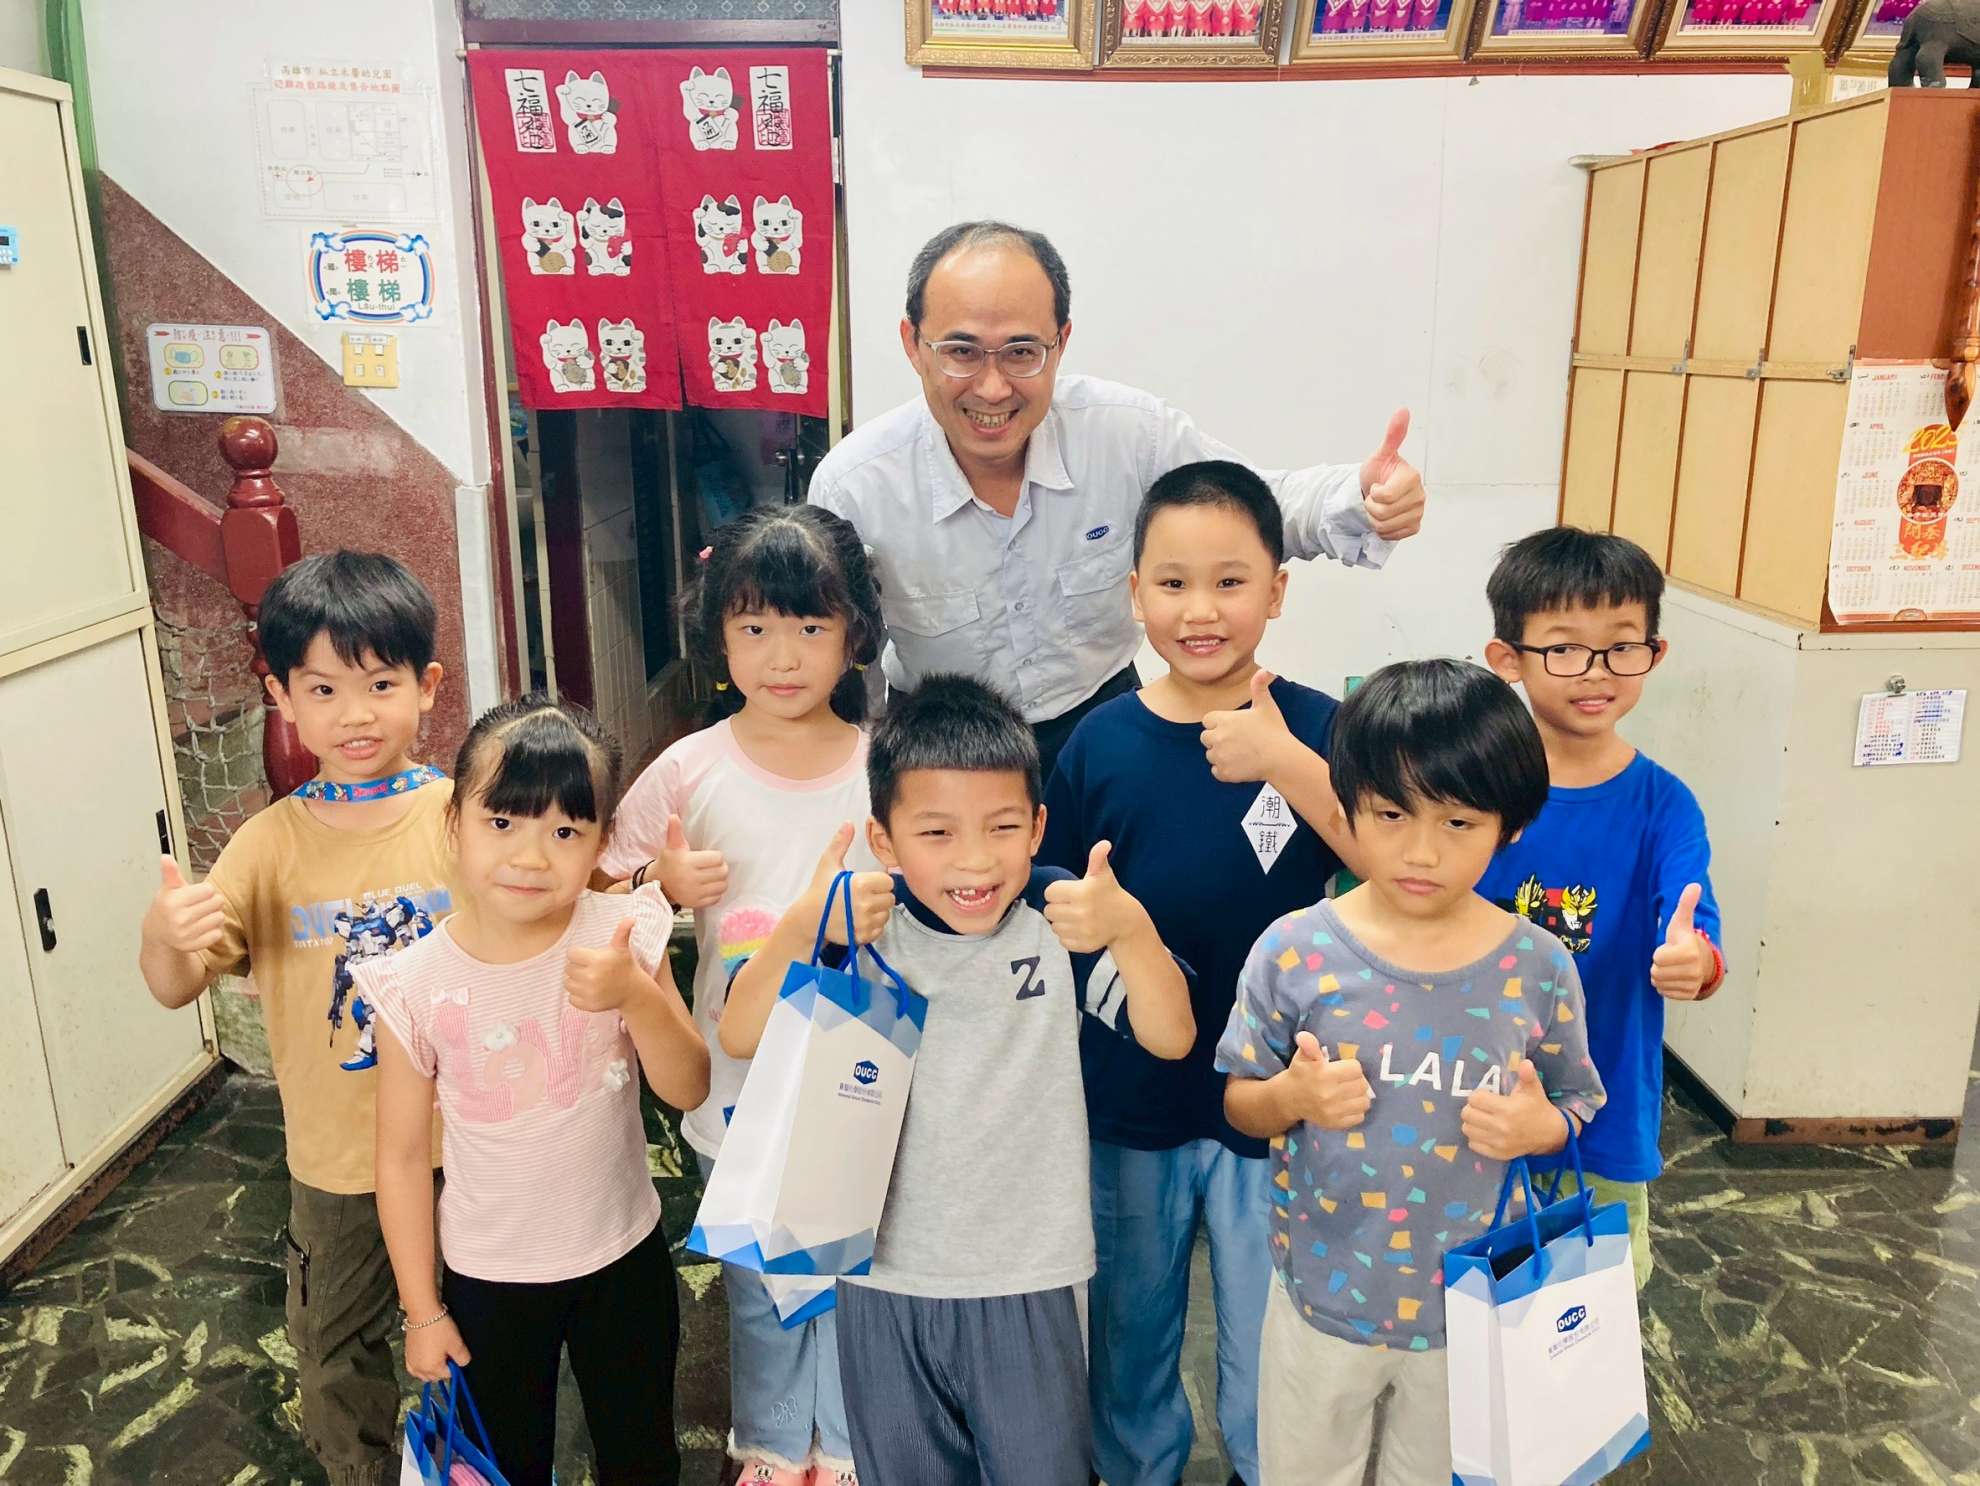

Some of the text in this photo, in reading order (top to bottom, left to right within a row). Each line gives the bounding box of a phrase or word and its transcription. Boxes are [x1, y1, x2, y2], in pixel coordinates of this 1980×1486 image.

[344, 248, 399, 273] 樓梯
[346, 278, 401, 302] 樓梯
[1010, 955, 1046, 1001] Z
[1321, 1043, 1501, 1097] LALA
[1557, 1307, 1586, 1330] OUCC
